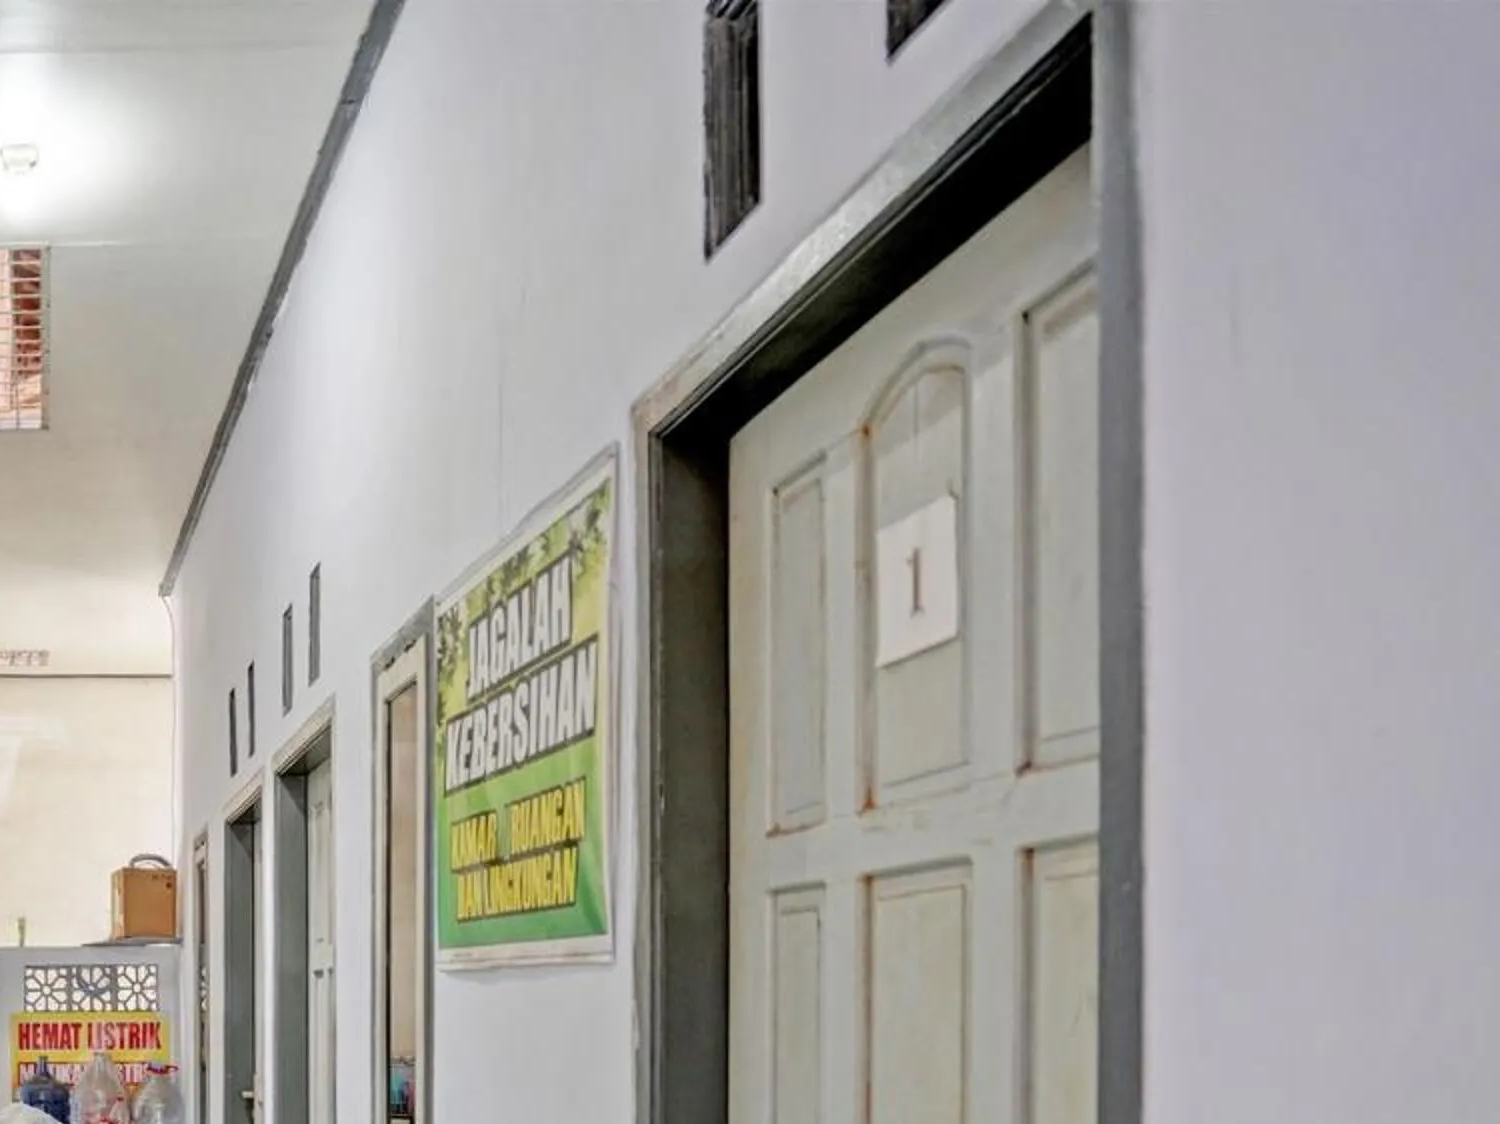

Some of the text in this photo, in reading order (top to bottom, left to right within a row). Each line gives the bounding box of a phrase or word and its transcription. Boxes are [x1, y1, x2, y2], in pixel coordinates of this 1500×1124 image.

[906, 547, 925, 618] 1
[468, 552, 572, 703] JAGALAH
[445, 636, 597, 797] KEBERSIHAN
[509, 777, 585, 857] RUANGAN
[18, 1021, 162, 1051] HEMAT LISTRIK
